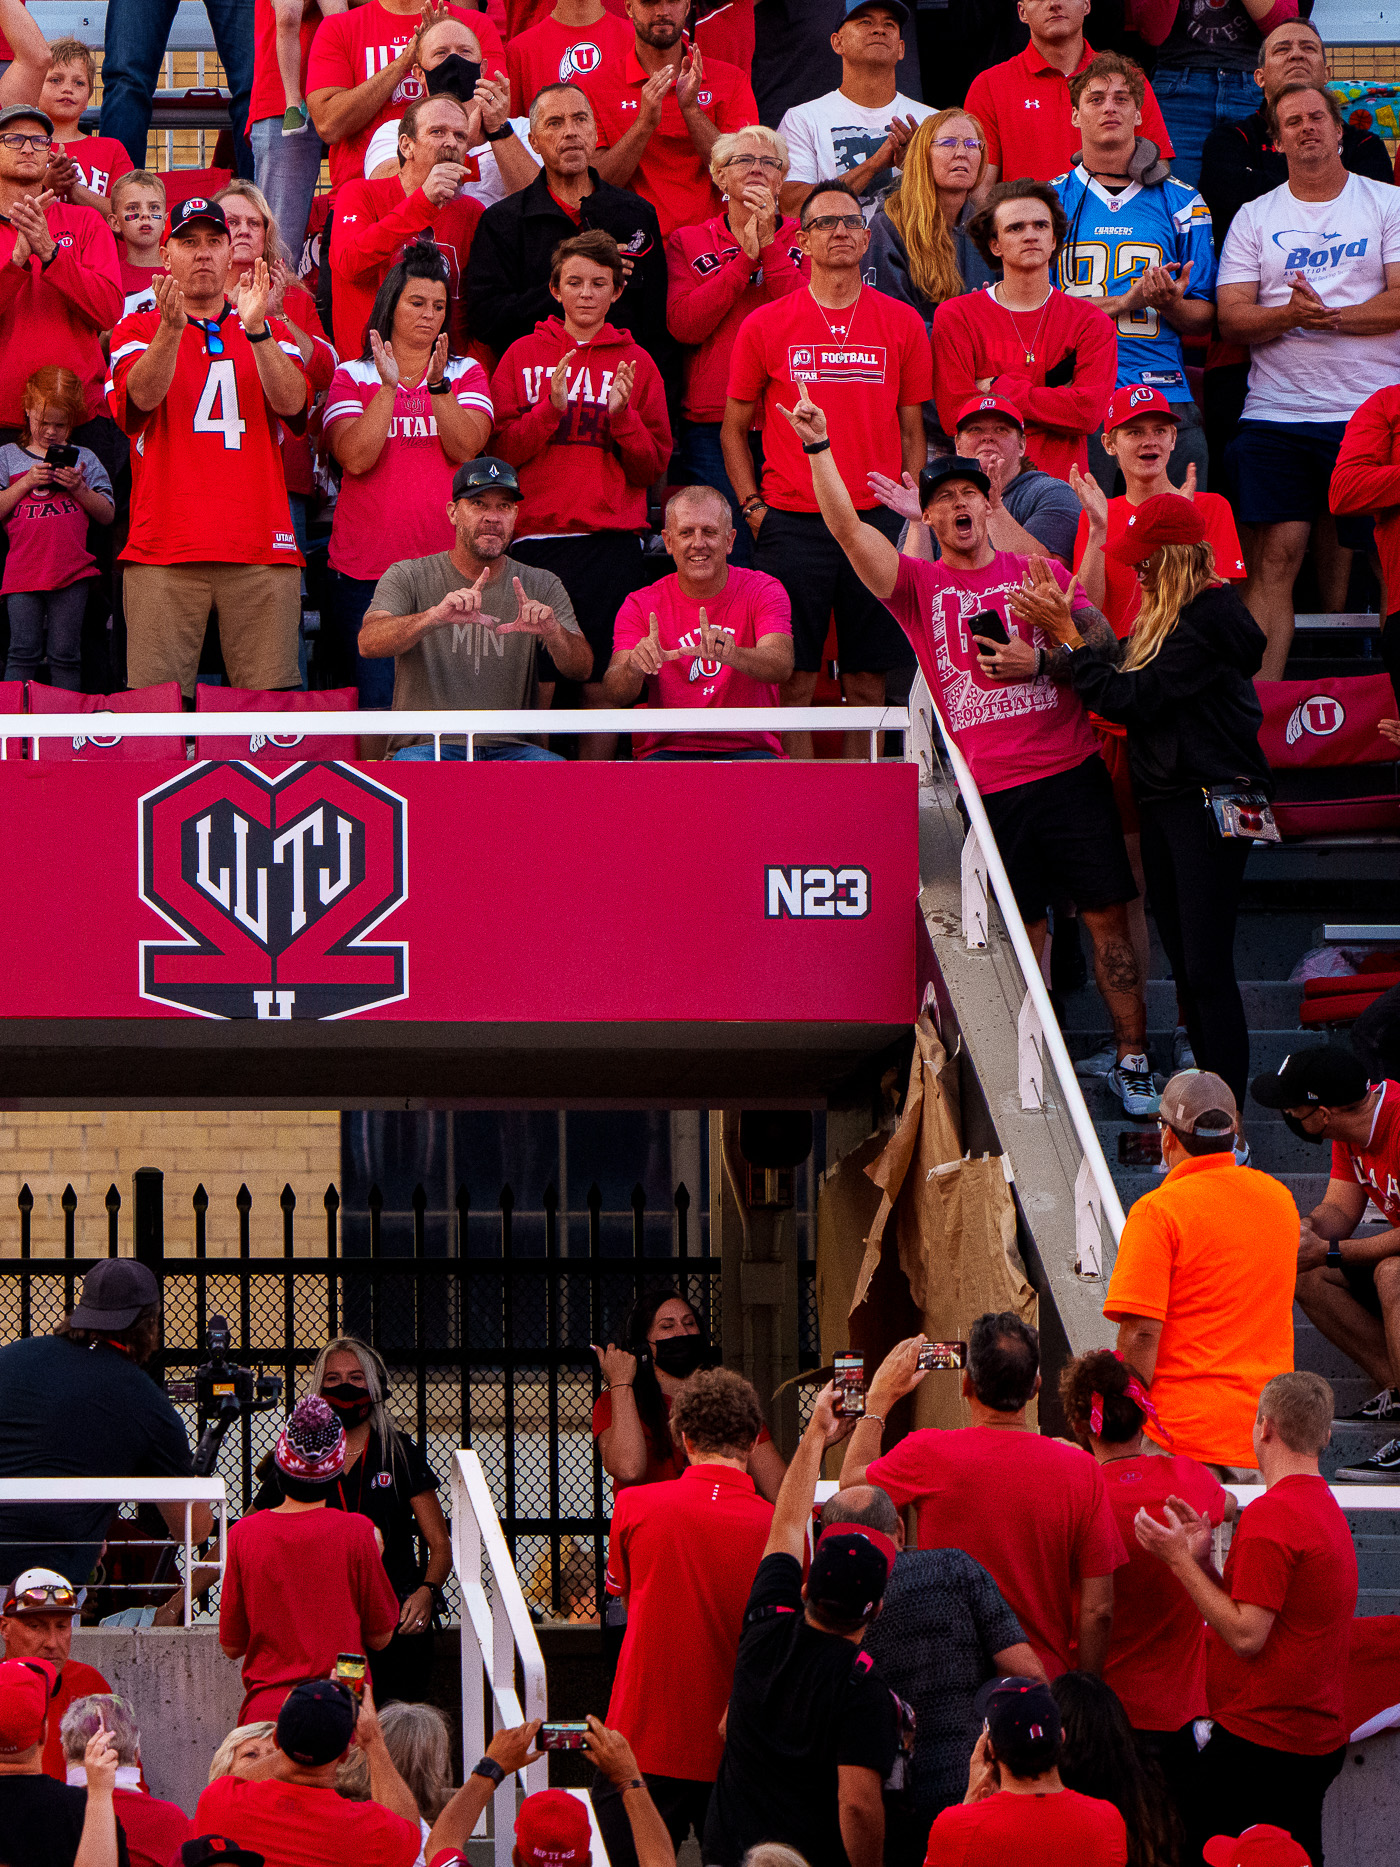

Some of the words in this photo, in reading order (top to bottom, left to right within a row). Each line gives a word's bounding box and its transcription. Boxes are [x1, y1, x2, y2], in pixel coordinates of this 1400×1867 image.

[83, 17, 90, 26] 5
[574, 48, 595, 70] U
[403, 81, 421, 96] U
[1094, 226, 1134, 236] CHARGERS
[1284, 238, 1369, 269] Boyd
[1283, 267, 1328, 277] AVATION
[821, 352, 879, 365] FOOTBALL
[793, 371, 818, 380] UTAH
[193, 358, 246, 451] 4
[13, 500, 79, 520] UTAH
[953, 691, 1056, 725] FOOTBALL
[1306, 702, 1337, 732] U
[768, 869, 868, 916] N23
[253, 990, 296, 1020] U
[548, 1851, 560, 1861] TY
